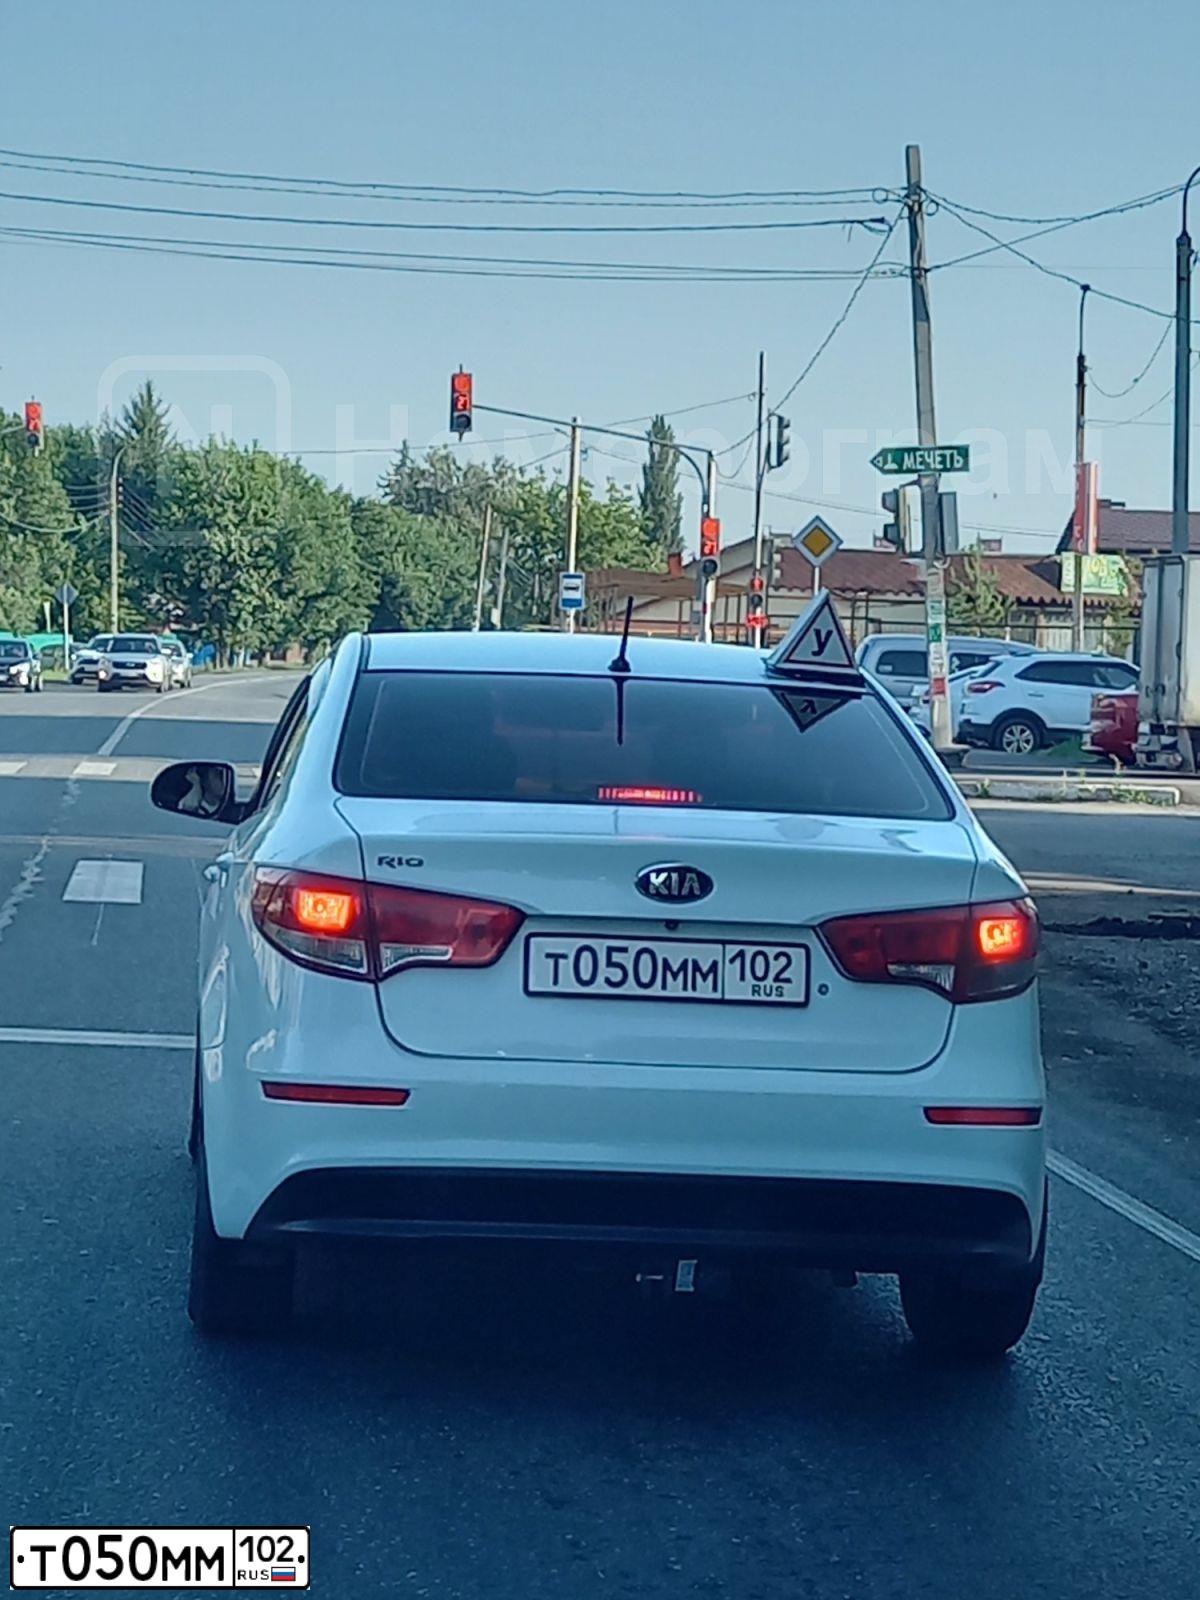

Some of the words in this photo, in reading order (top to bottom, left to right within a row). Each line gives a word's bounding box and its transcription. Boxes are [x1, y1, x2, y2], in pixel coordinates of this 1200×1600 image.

[903, 449, 964, 470] МЕЧЕТЬ
[811, 628, 833, 656] У
[377, 855, 424, 868] RIO
[649, 872, 701, 896] KIA
[545, 944, 719, 993] Т050ММ
[729, 949, 792, 984] 102
[752, 985, 784, 998] RUS
